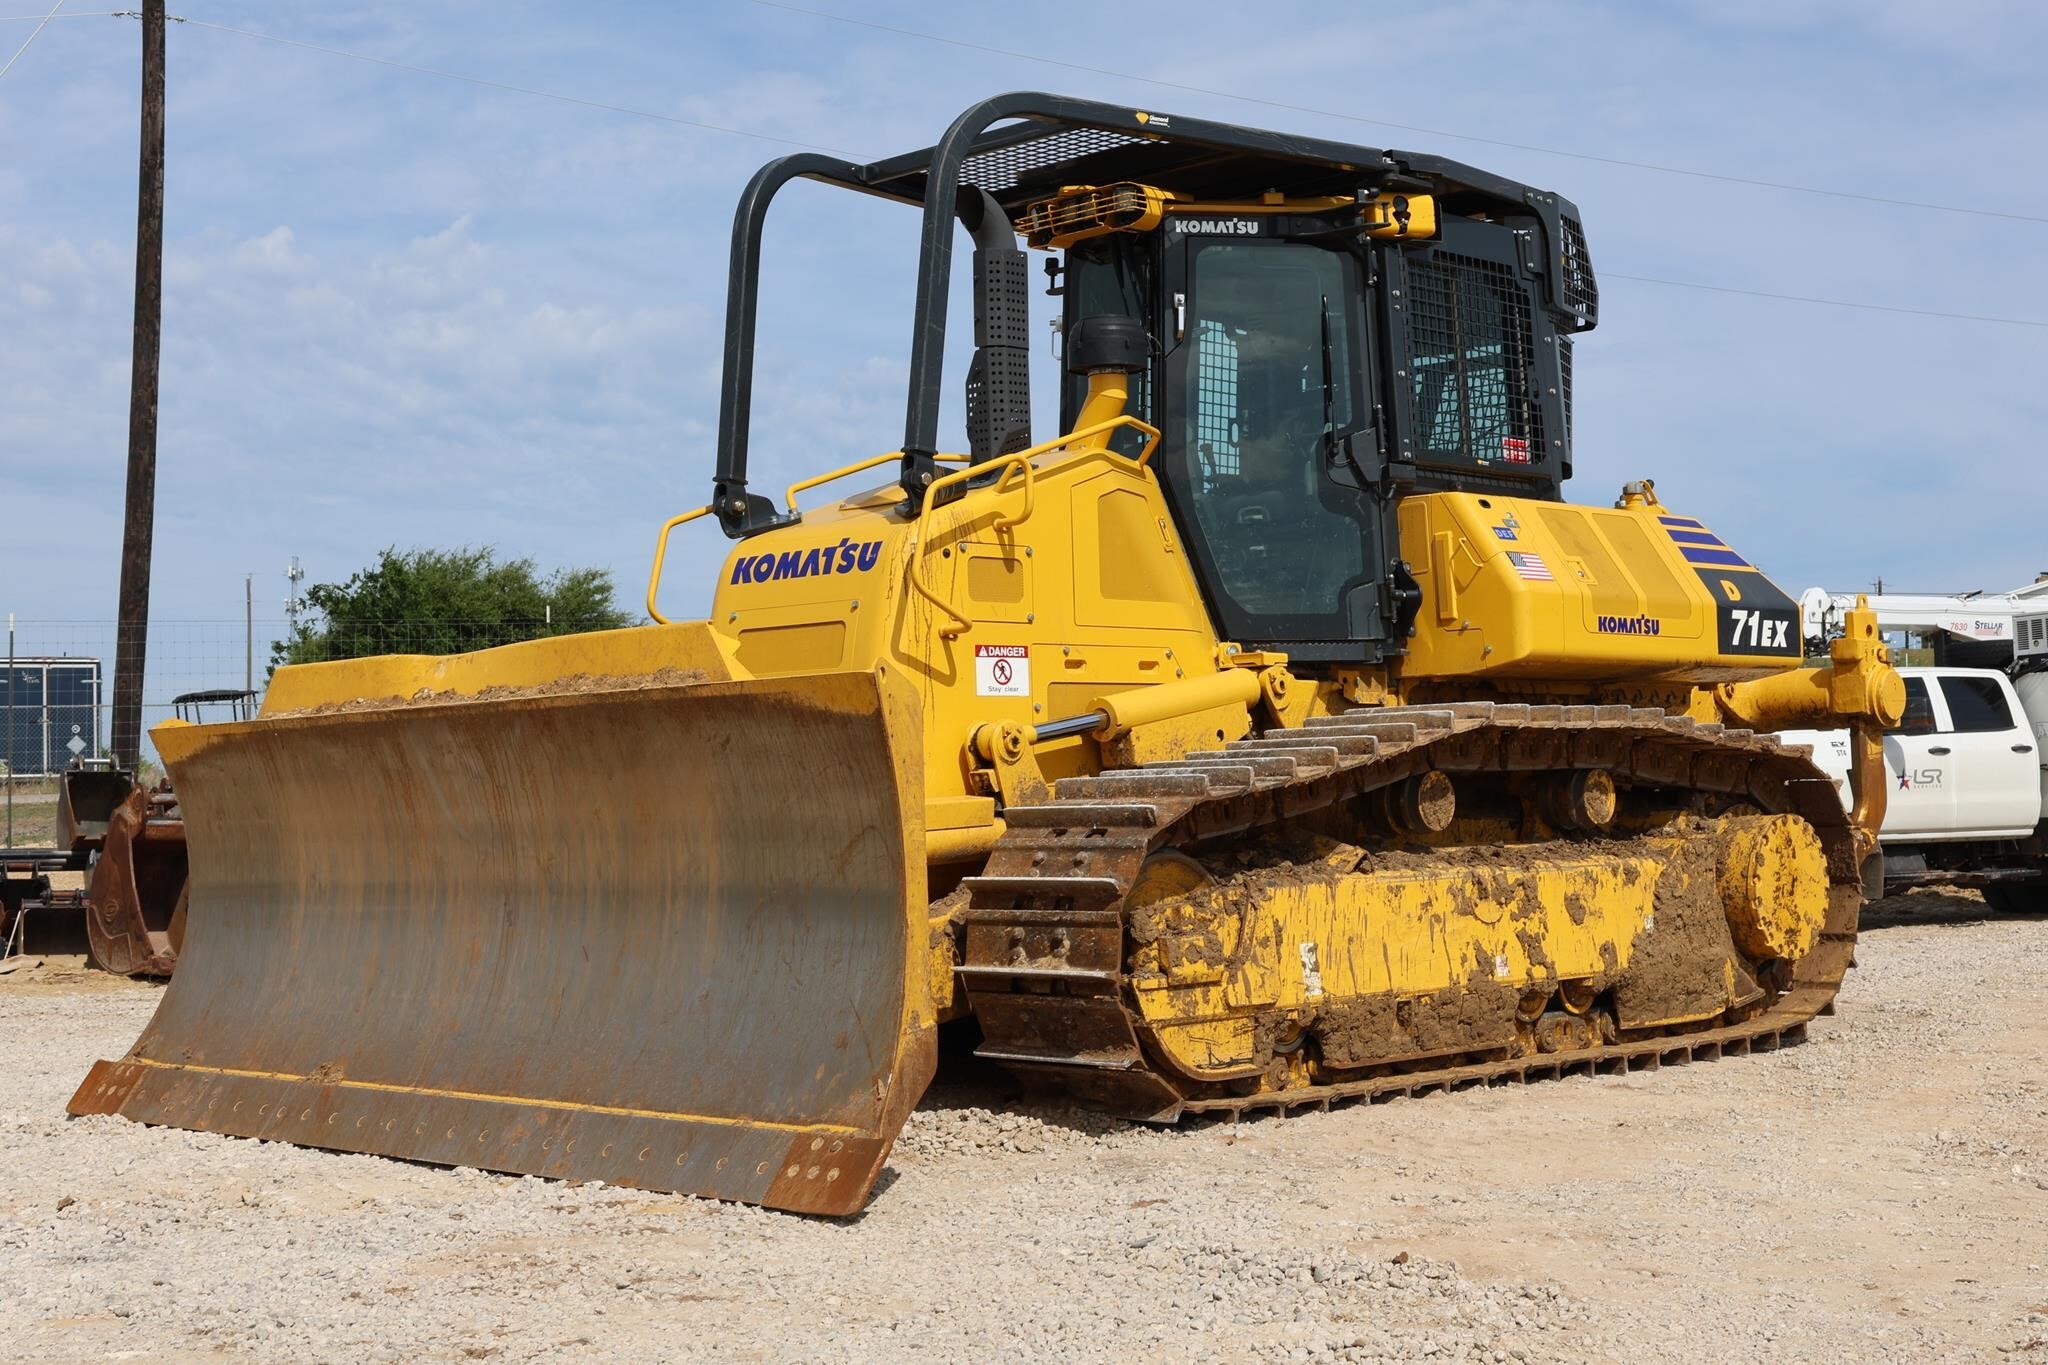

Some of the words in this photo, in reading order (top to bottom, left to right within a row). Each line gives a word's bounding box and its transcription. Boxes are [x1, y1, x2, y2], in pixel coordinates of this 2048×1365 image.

[1175, 217, 1259, 234] KOMATSU
[1495, 528, 1514, 538] DEF
[730, 537, 883, 585] KOMATSU
[1719, 579, 1742, 602] D
[1598, 614, 1660, 635] KOMATSU
[1950, 622, 1968, 631] 7630
[988, 646, 1025, 657] DANGER
[988, 685, 1001, 693] Stay
[1913, 769, 1942, 784] LSR
